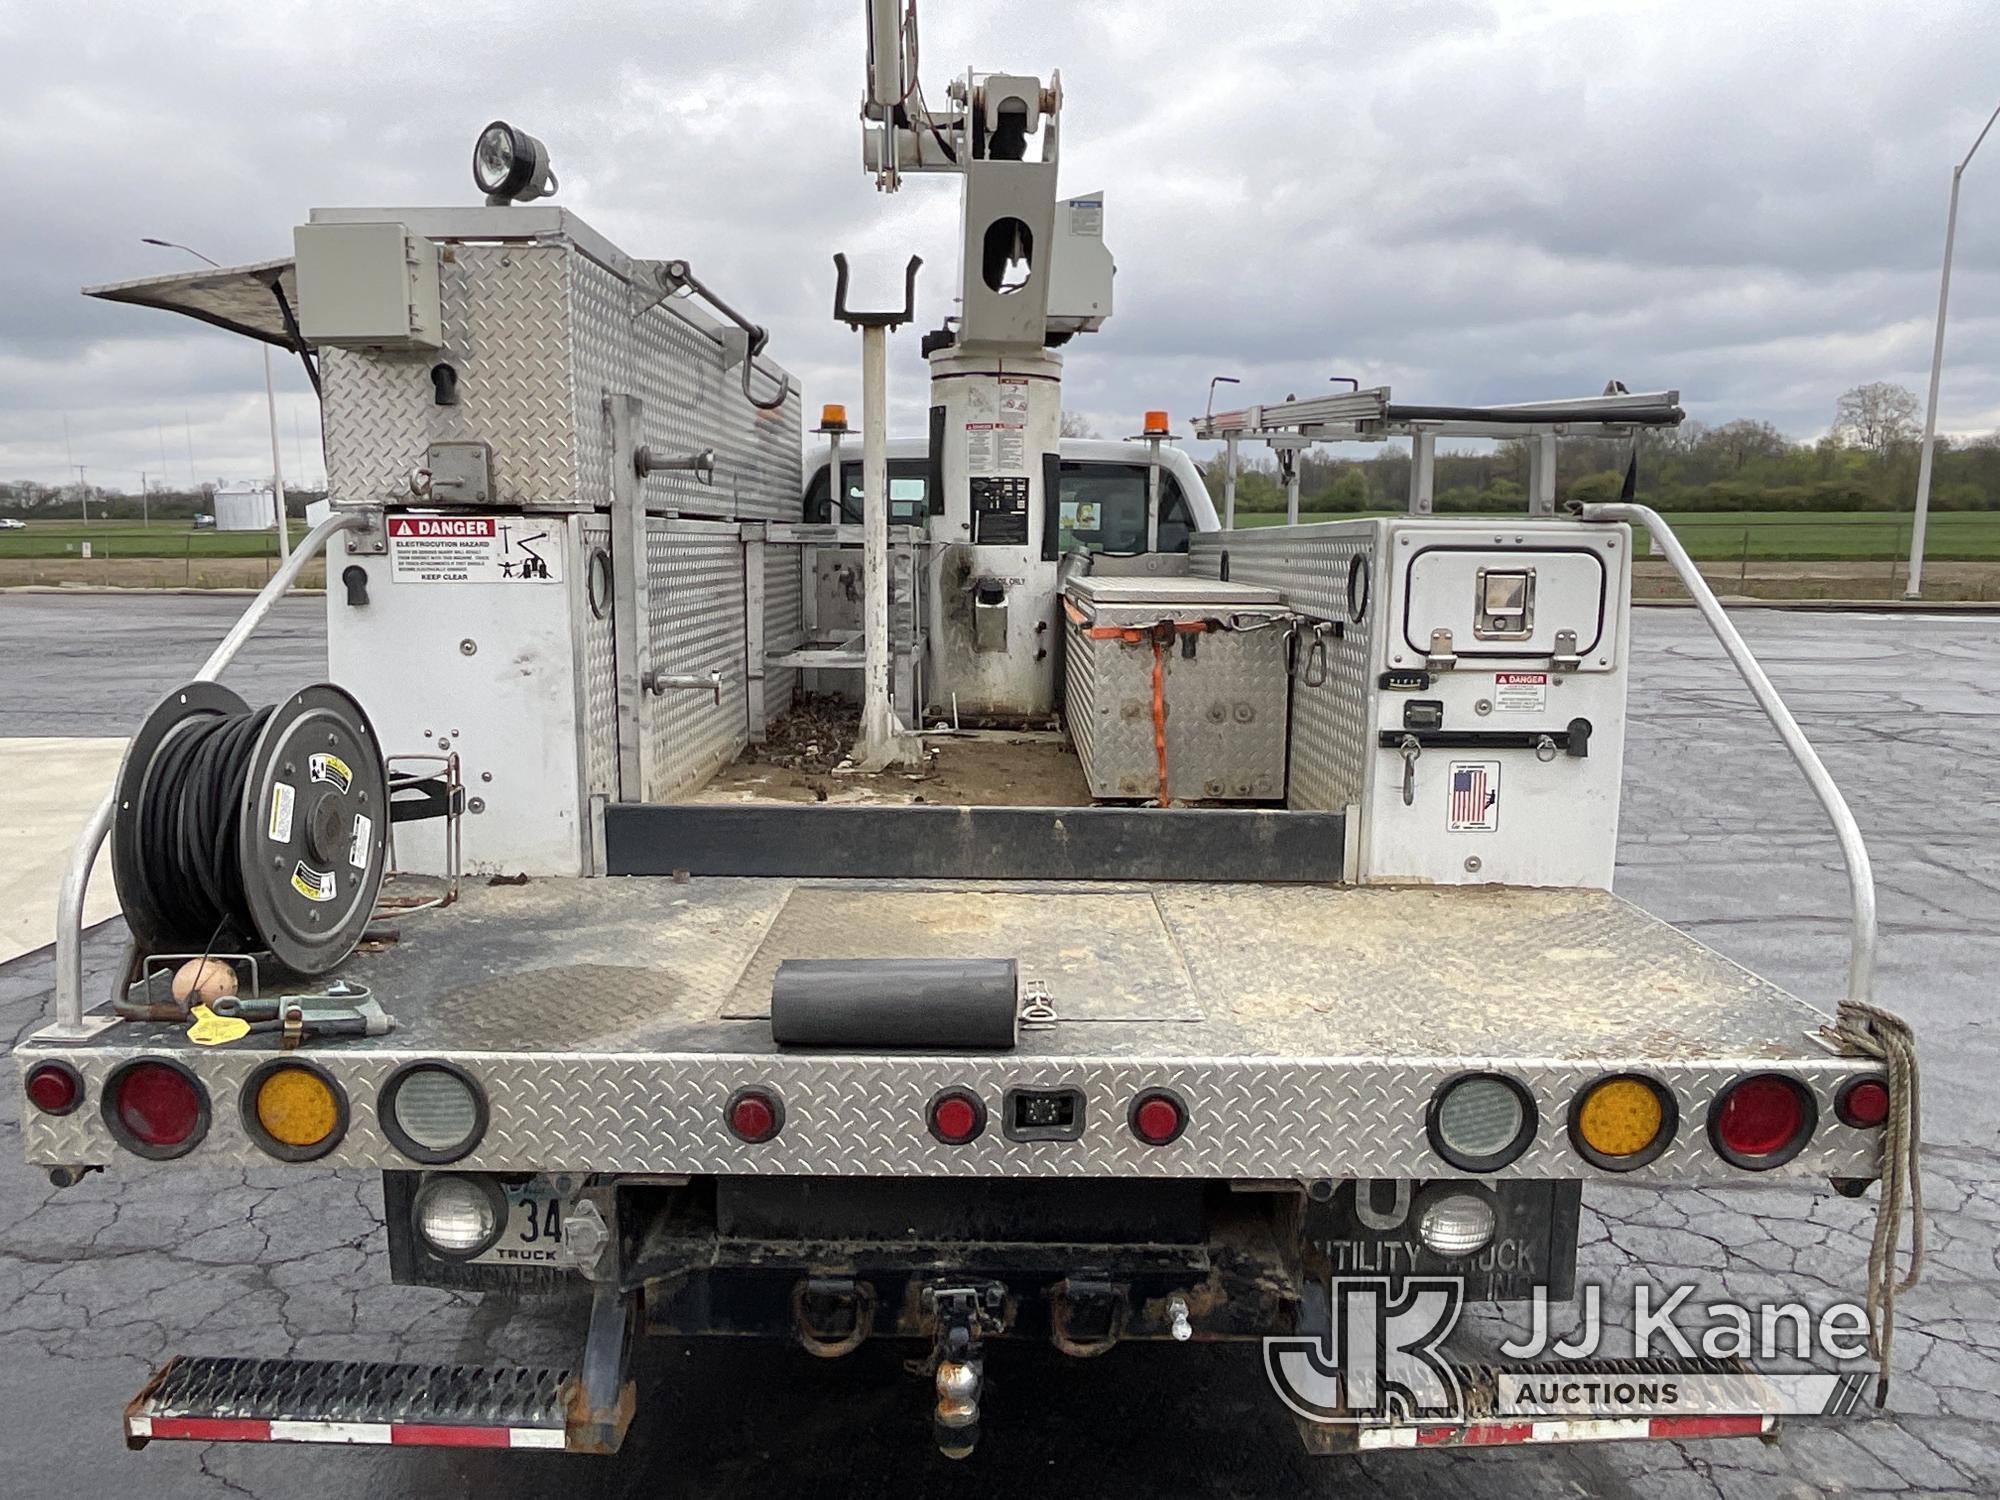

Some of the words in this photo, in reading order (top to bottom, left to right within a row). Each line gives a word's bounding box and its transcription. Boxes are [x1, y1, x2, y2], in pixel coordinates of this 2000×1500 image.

[418, 521, 489, 535] DANGER
[1508, 675, 1544, 684] DANGER
[518, 1198, 562, 1243] 34
[496, 1248, 556, 1260] TRUCK
